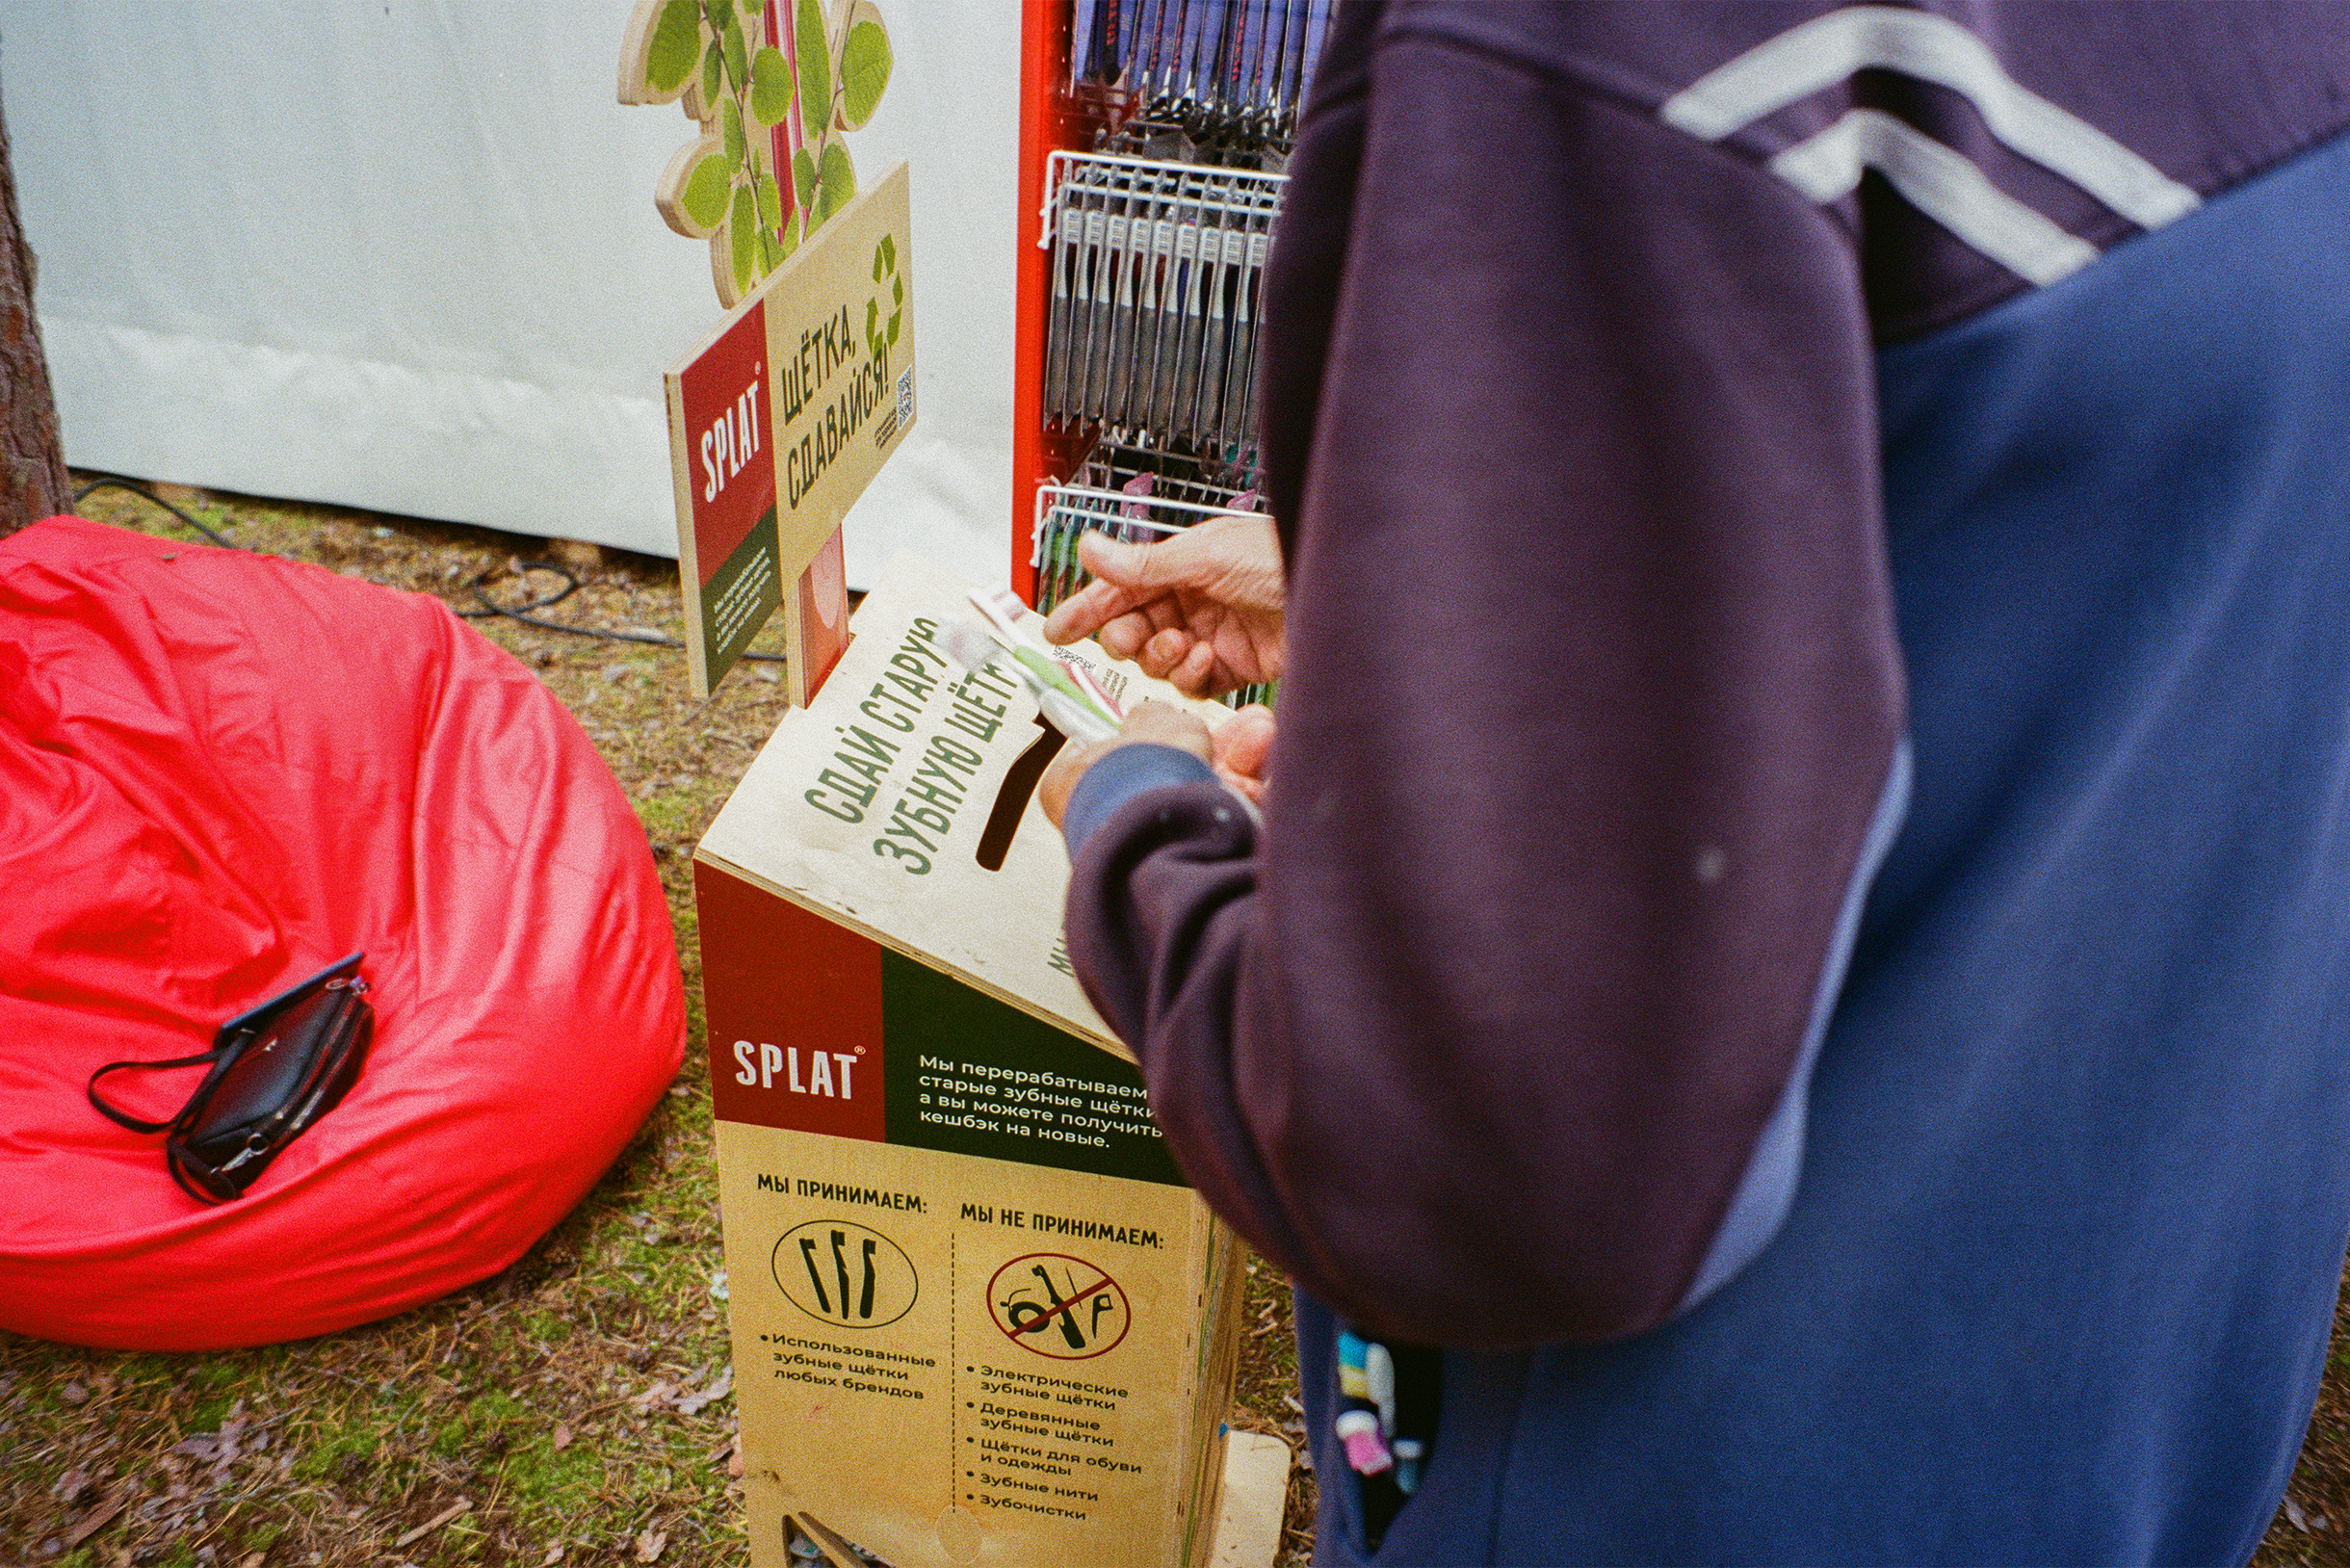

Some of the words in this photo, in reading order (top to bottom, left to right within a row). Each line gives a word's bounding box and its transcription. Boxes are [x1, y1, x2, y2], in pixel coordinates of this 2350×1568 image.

[782, 304, 856, 426] ЩЁТКА,
[788, 343, 889, 510] СДАВАЙСЯ!
[804, 725, 901, 823] СДАЙ
[873, 735, 983, 875] ЗУБНУЮ
[944, 661, 1018, 743] ЩЁТК
[919, 1075, 997, 1095] старые
[1005, 1086, 1083, 1108] зубные
[920, 1055, 954, 1072] Мы
[962, 1062, 1148, 1100] перерабатываем
[920, 1093, 931, 1104] а
[939, 1095, 966, 1109] вы
[974, 1100, 1054, 1122] можете
[1061, 1112, 1163, 1138] получить
[920, 1111, 1000, 1132] кешбэк
[1006, 1123, 1031, 1137] на
[1038, 1127, 1110, 1148] новые.
[758, 1173, 789, 1193] МЫ
[796, 1179, 927, 1214] ПРИНИМАЕМ:
[961, 1202, 992, 1224] МЫ
[1001, 1208, 1025, 1228] НЕ
[1032, 1214, 1164, 1250] ПРИНИМАЕМ:
[772, 1333, 936, 1368] Использованные
[772, 1352, 843, 1371] зубные
[849, 1363, 909, 1380] щётки
[773, 1369, 838, 1387] любых
[843, 1377, 925, 1399] брендов
[980, 1365, 1129, 1398] Электрические
[980, 1381, 1051, 1399] зубные
[1057, 1394, 1116, 1411] щётки
[980, 1401, 1101, 1431] Деревянные
[980, 1418, 1050, 1436] зубные
[1055, 1429, 1114, 1448] щётки
[980, 1438, 1042, 1457] Щётки
[1047, 1450, 1081, 1464] для
[1086, 1457, 1142, 1474] обуви
[980, 1453, 992, 1463] и
[997, 1455, 1072, 1477] одежды
[980, 1473, 1050, 1493] Зубные
[1055, 1487, 1099, 1503] нити
[980, 1494, 1086, 1521] Зубочистки
